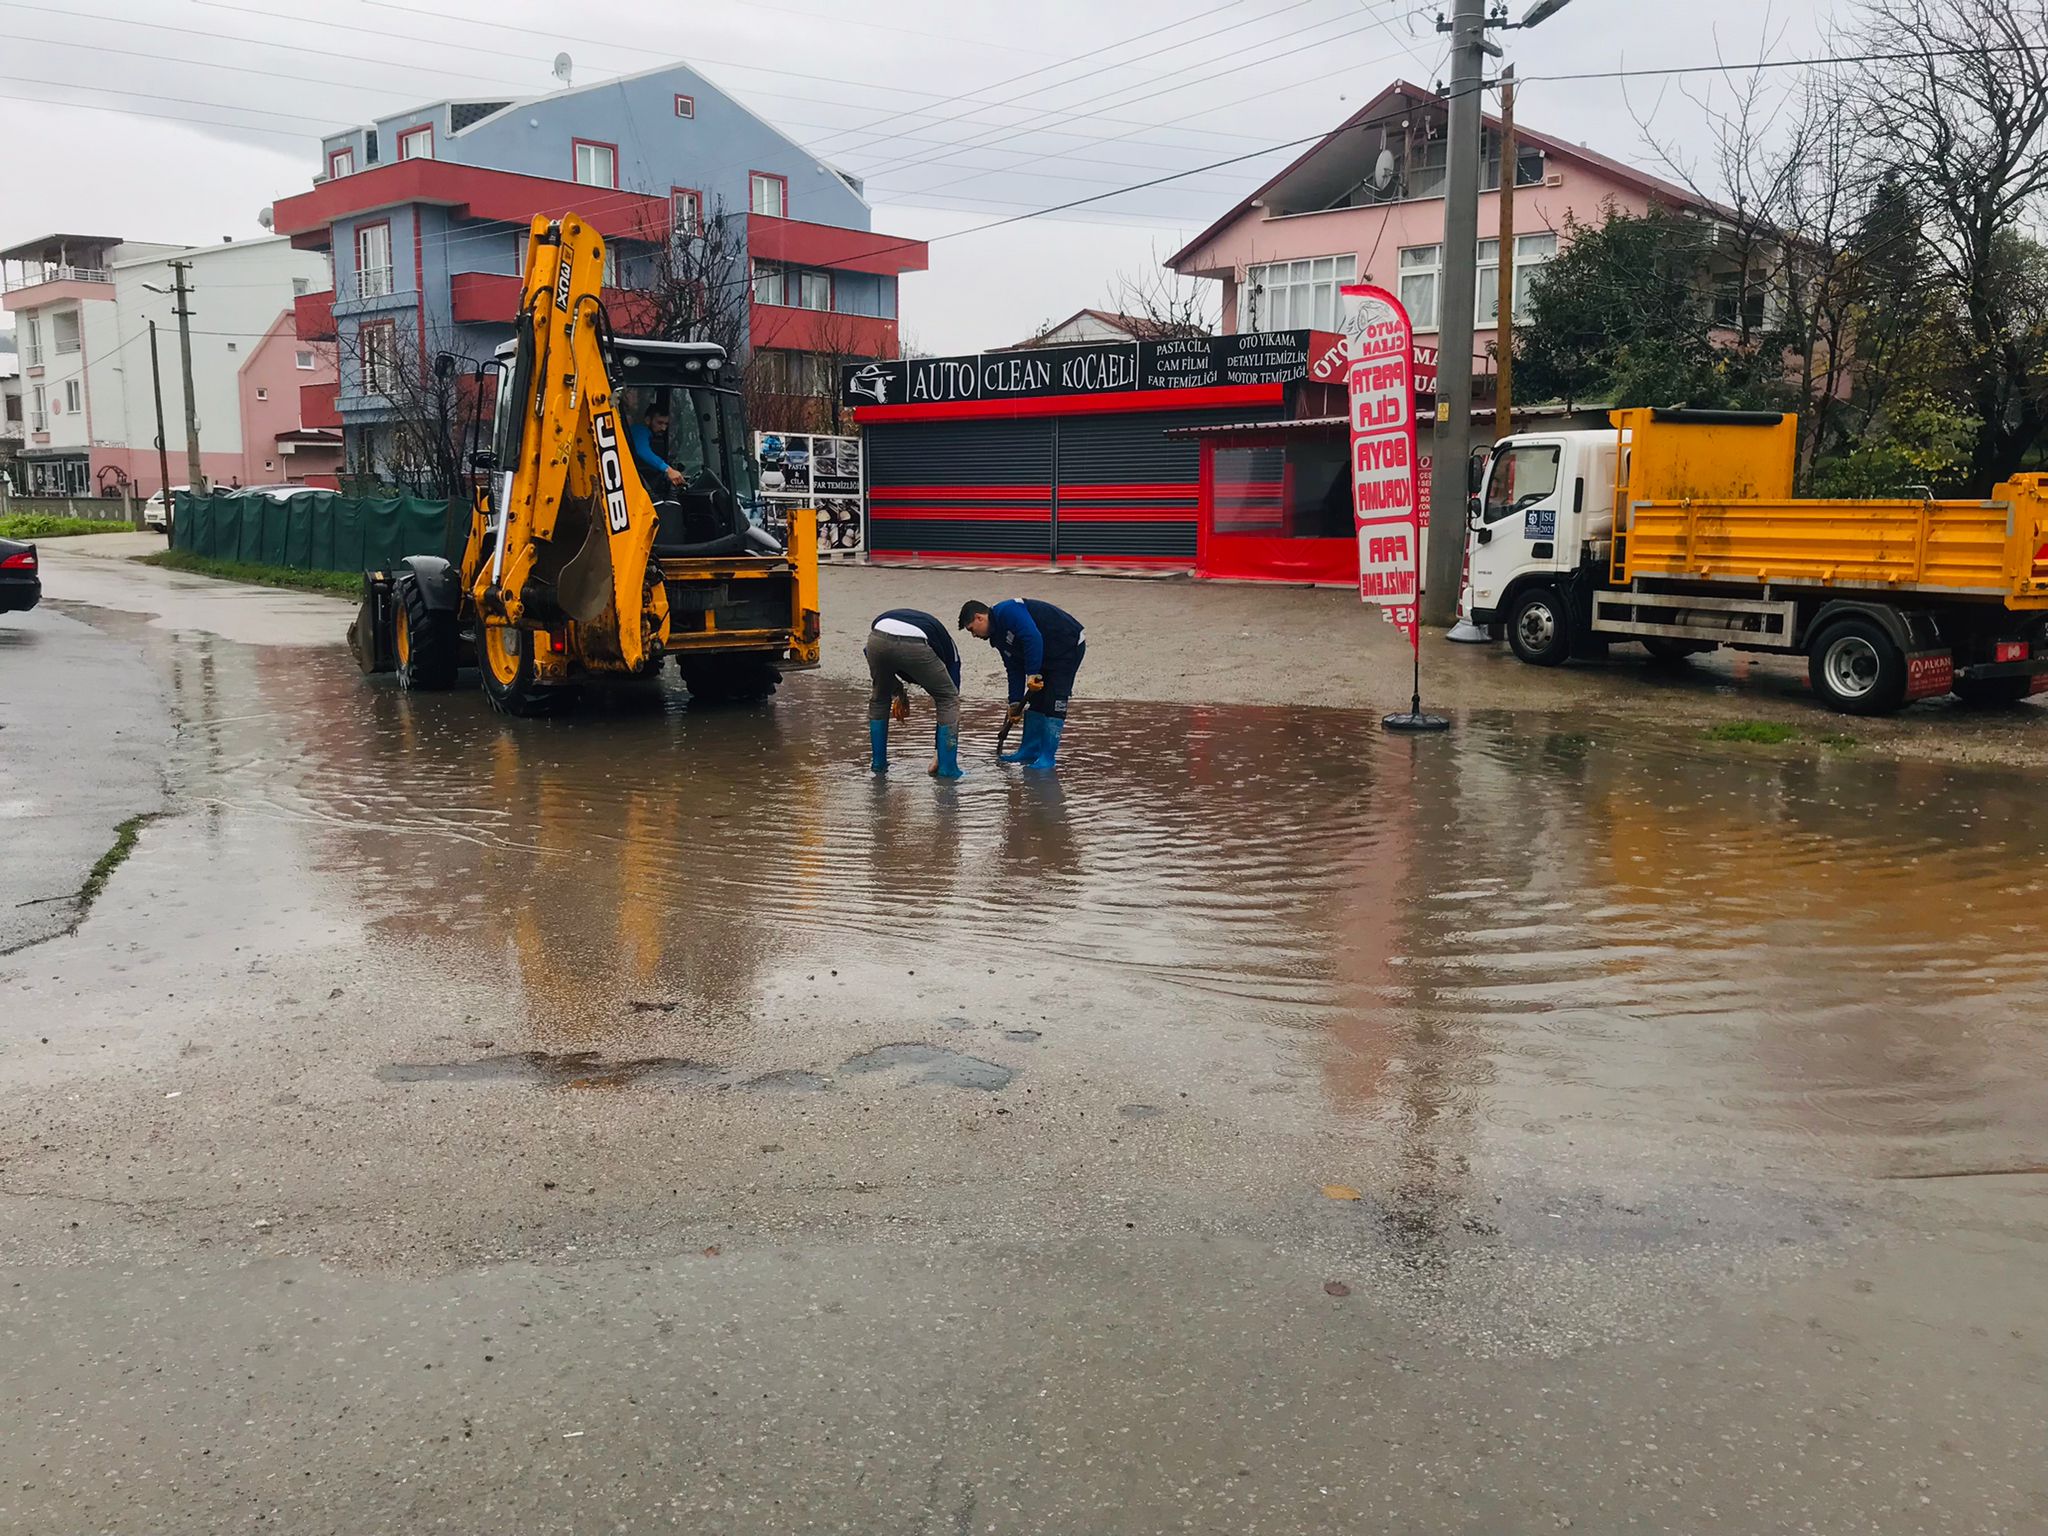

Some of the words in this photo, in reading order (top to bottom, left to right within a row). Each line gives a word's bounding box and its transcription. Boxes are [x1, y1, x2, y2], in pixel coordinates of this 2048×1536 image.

[557, 262, 571, 307] 3CX
[1156, 341, 1186, 356] PASTA
[1187, 338, 1211, 353] CİLA
[1239, 335, 1258, 350] OTO
[1259, 333, 1296, 347] YIKAMA
[1157, 360, 1179, 371] CAM
[1181, 356, 1209, 371] FİLMİ
[1227, 353, 1263, 367] DETAYLI
[1264, 350, 1307, 366] TEMİZLİK
[913, 361, 975, 400] AUTO
[984, 359, 1051, 392] CLEAN
[1148, 375, 1165, 388] FAR
[1227, 370, 1258, 384] MOTOR
[596, 416, 628, 531] JCB
